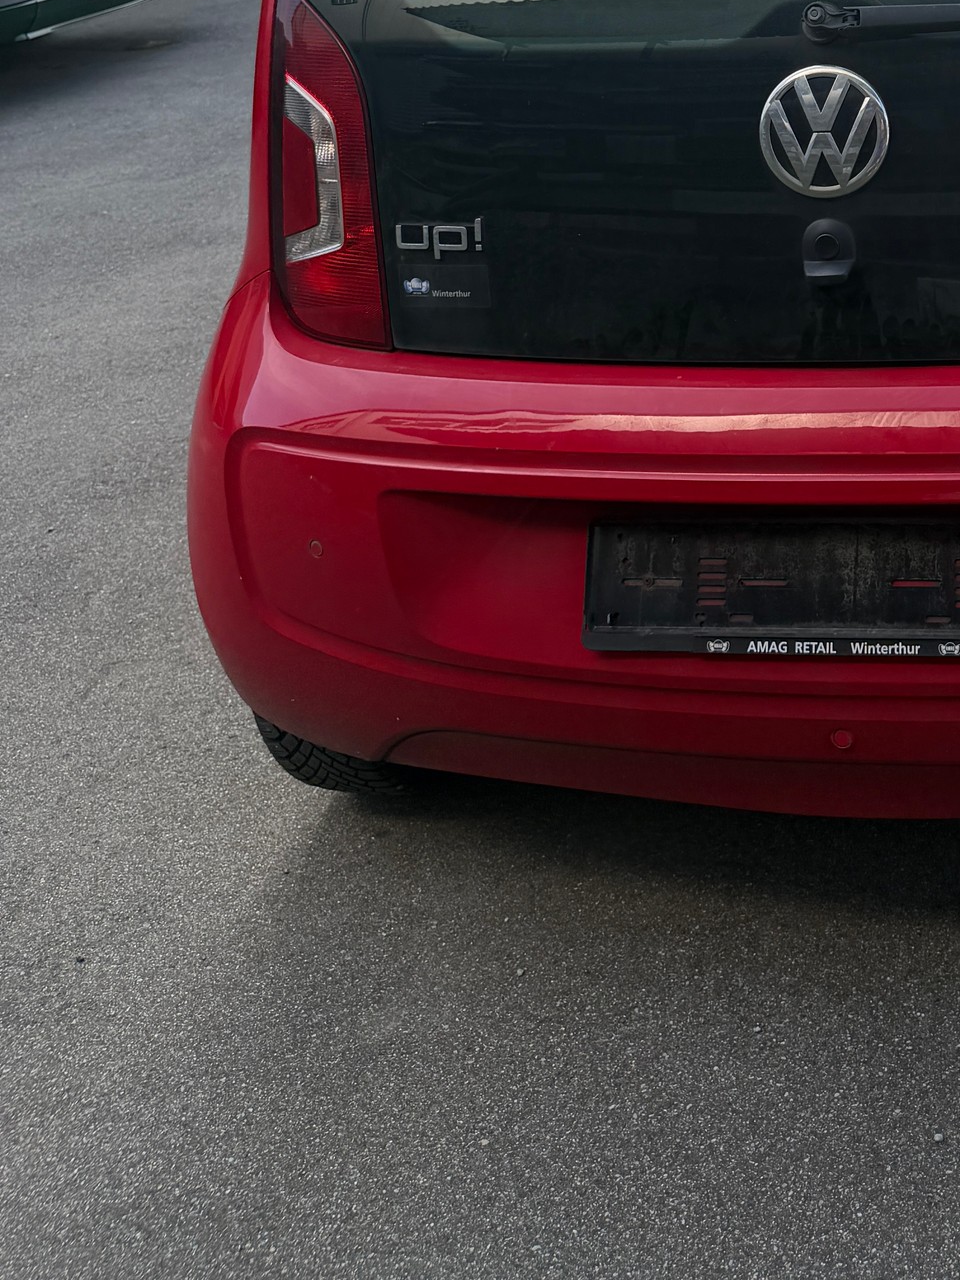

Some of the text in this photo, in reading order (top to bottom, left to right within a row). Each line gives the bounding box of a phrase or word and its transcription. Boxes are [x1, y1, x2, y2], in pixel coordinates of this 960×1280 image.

[396, 218, 482, 259] up!
[431, 289, 471, 298] Winterthur
[747, 640, 921, 655] AMAG RETAIL Winterthur
